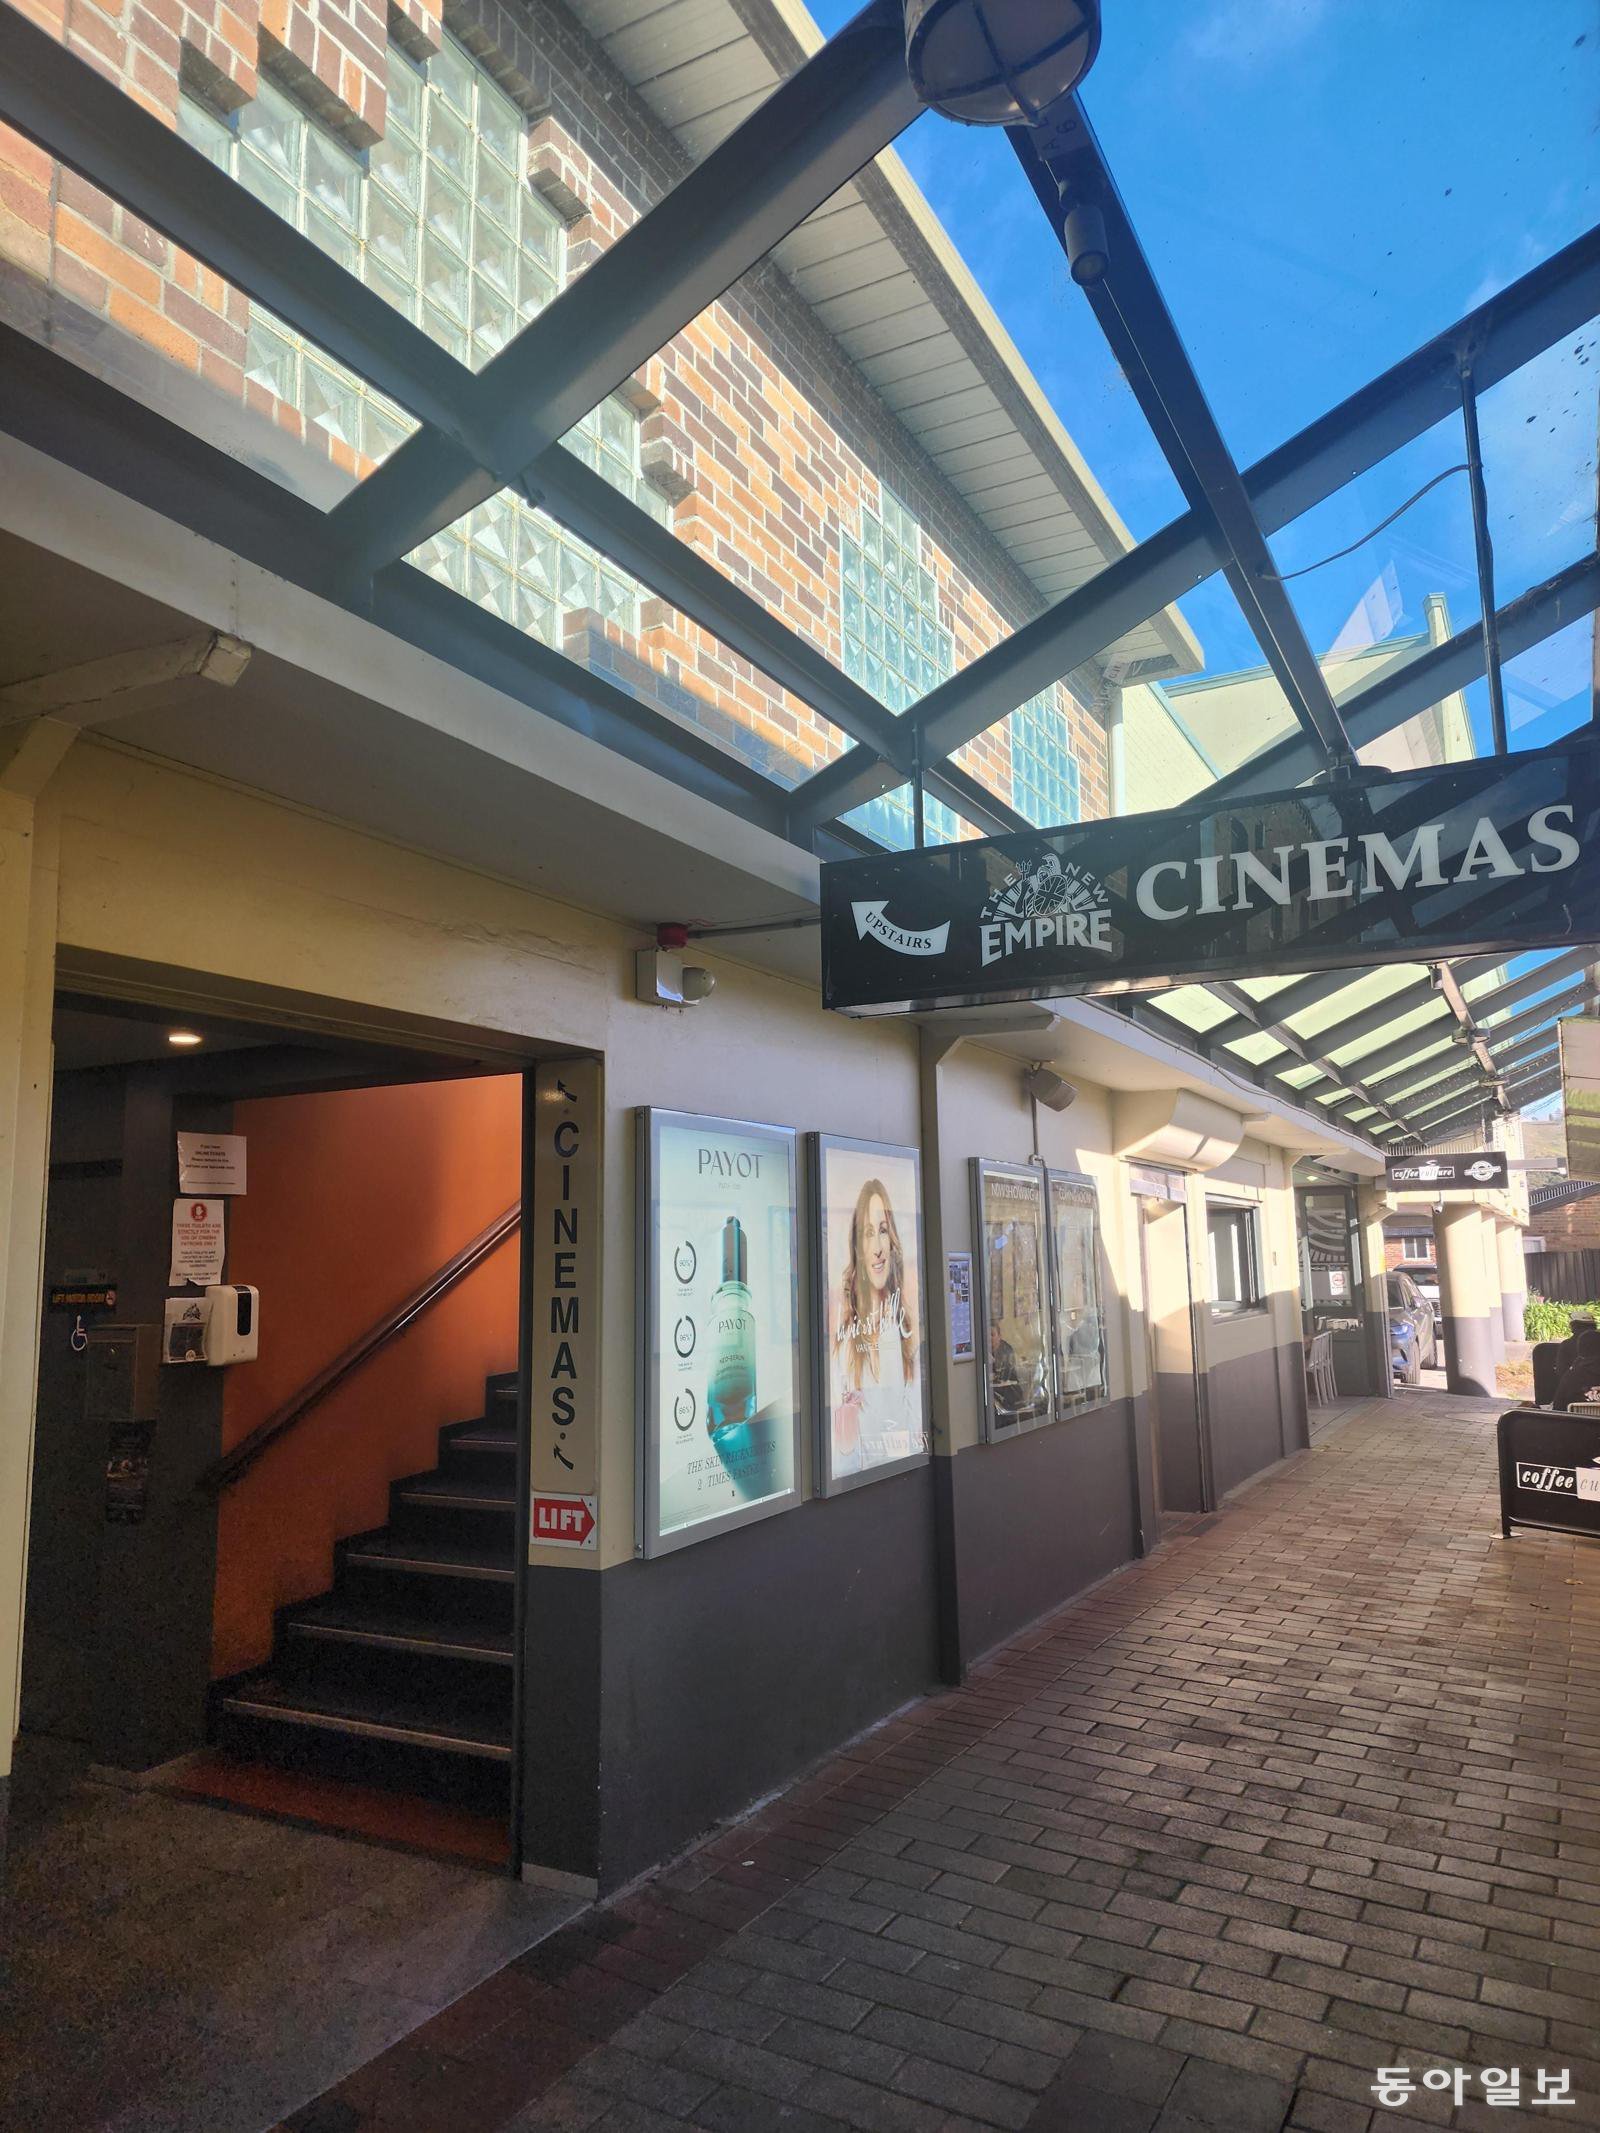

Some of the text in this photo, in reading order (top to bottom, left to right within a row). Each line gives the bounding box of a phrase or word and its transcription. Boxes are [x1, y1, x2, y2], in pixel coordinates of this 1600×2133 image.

[1136, 805, 1580, 921] CINEMAS
[980, 862, 1109, 919] THE NEW
[865, 911, 932, 949] UPSTAIRS
[980, 908, 1113, 968] EMPIRE
[698, 1149, 764, 1179] PAYOT
[1394, 1167, 1419, 1179] coffee
[549, 1120, 581, 1427] CINEMAS
[718, 1318, 746, 1333] PAYOT
[1522, 1467, 1574, 1491] coffee
[538, 1508, 585, 1533] LIFT
